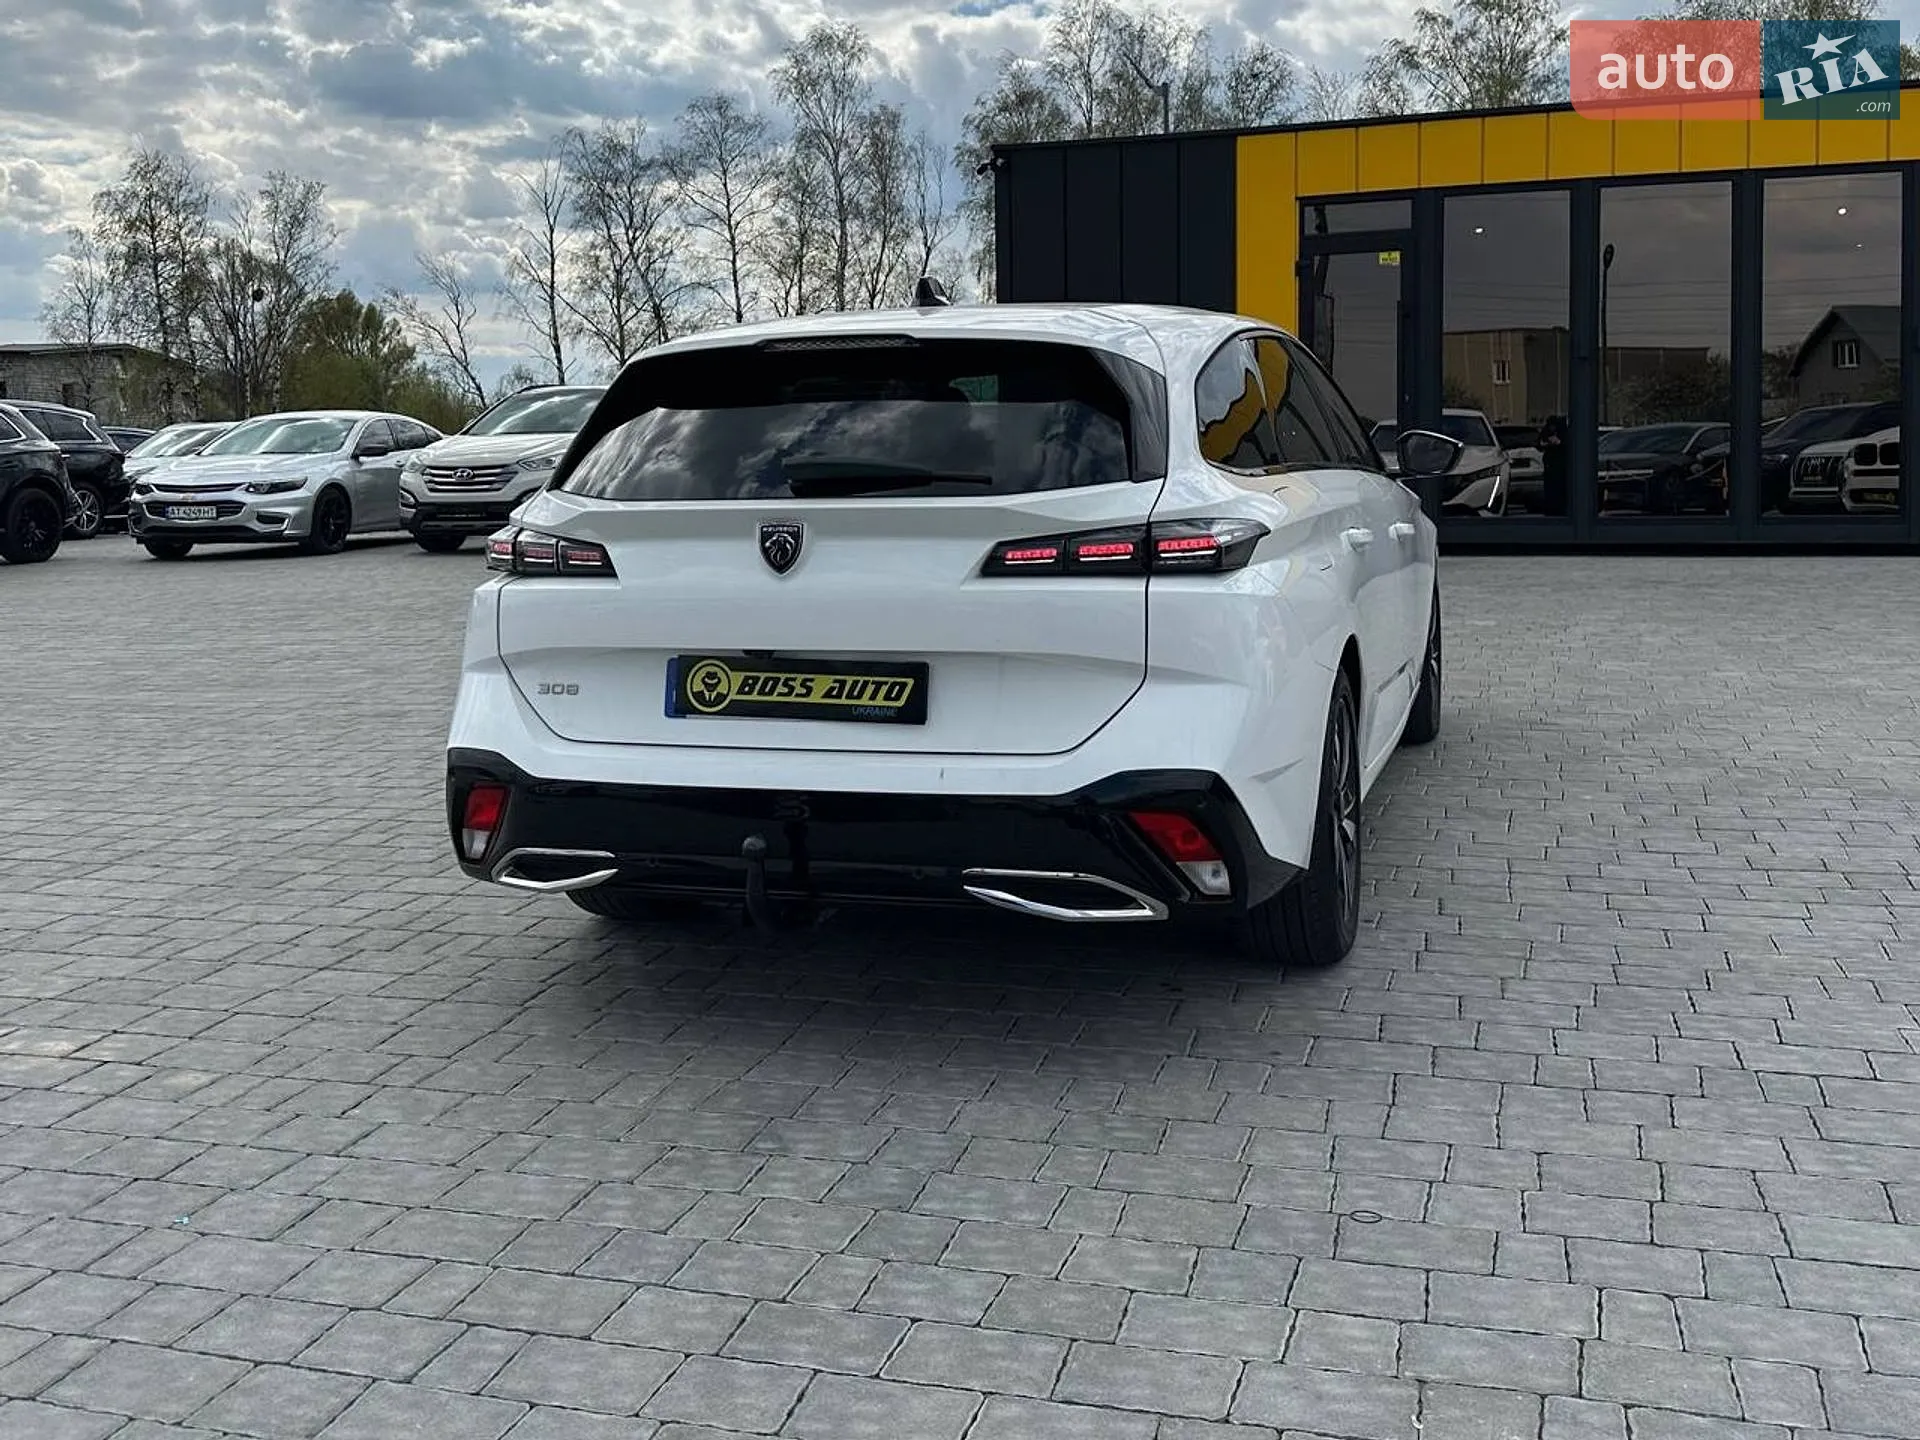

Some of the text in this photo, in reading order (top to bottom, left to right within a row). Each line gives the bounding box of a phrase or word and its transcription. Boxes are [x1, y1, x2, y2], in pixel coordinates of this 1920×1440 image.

[537, 683, 580, 696] 308
[735, 674, 909, 702] BOSS AUTO
[852, 706, 898, 718] UKRAINE
